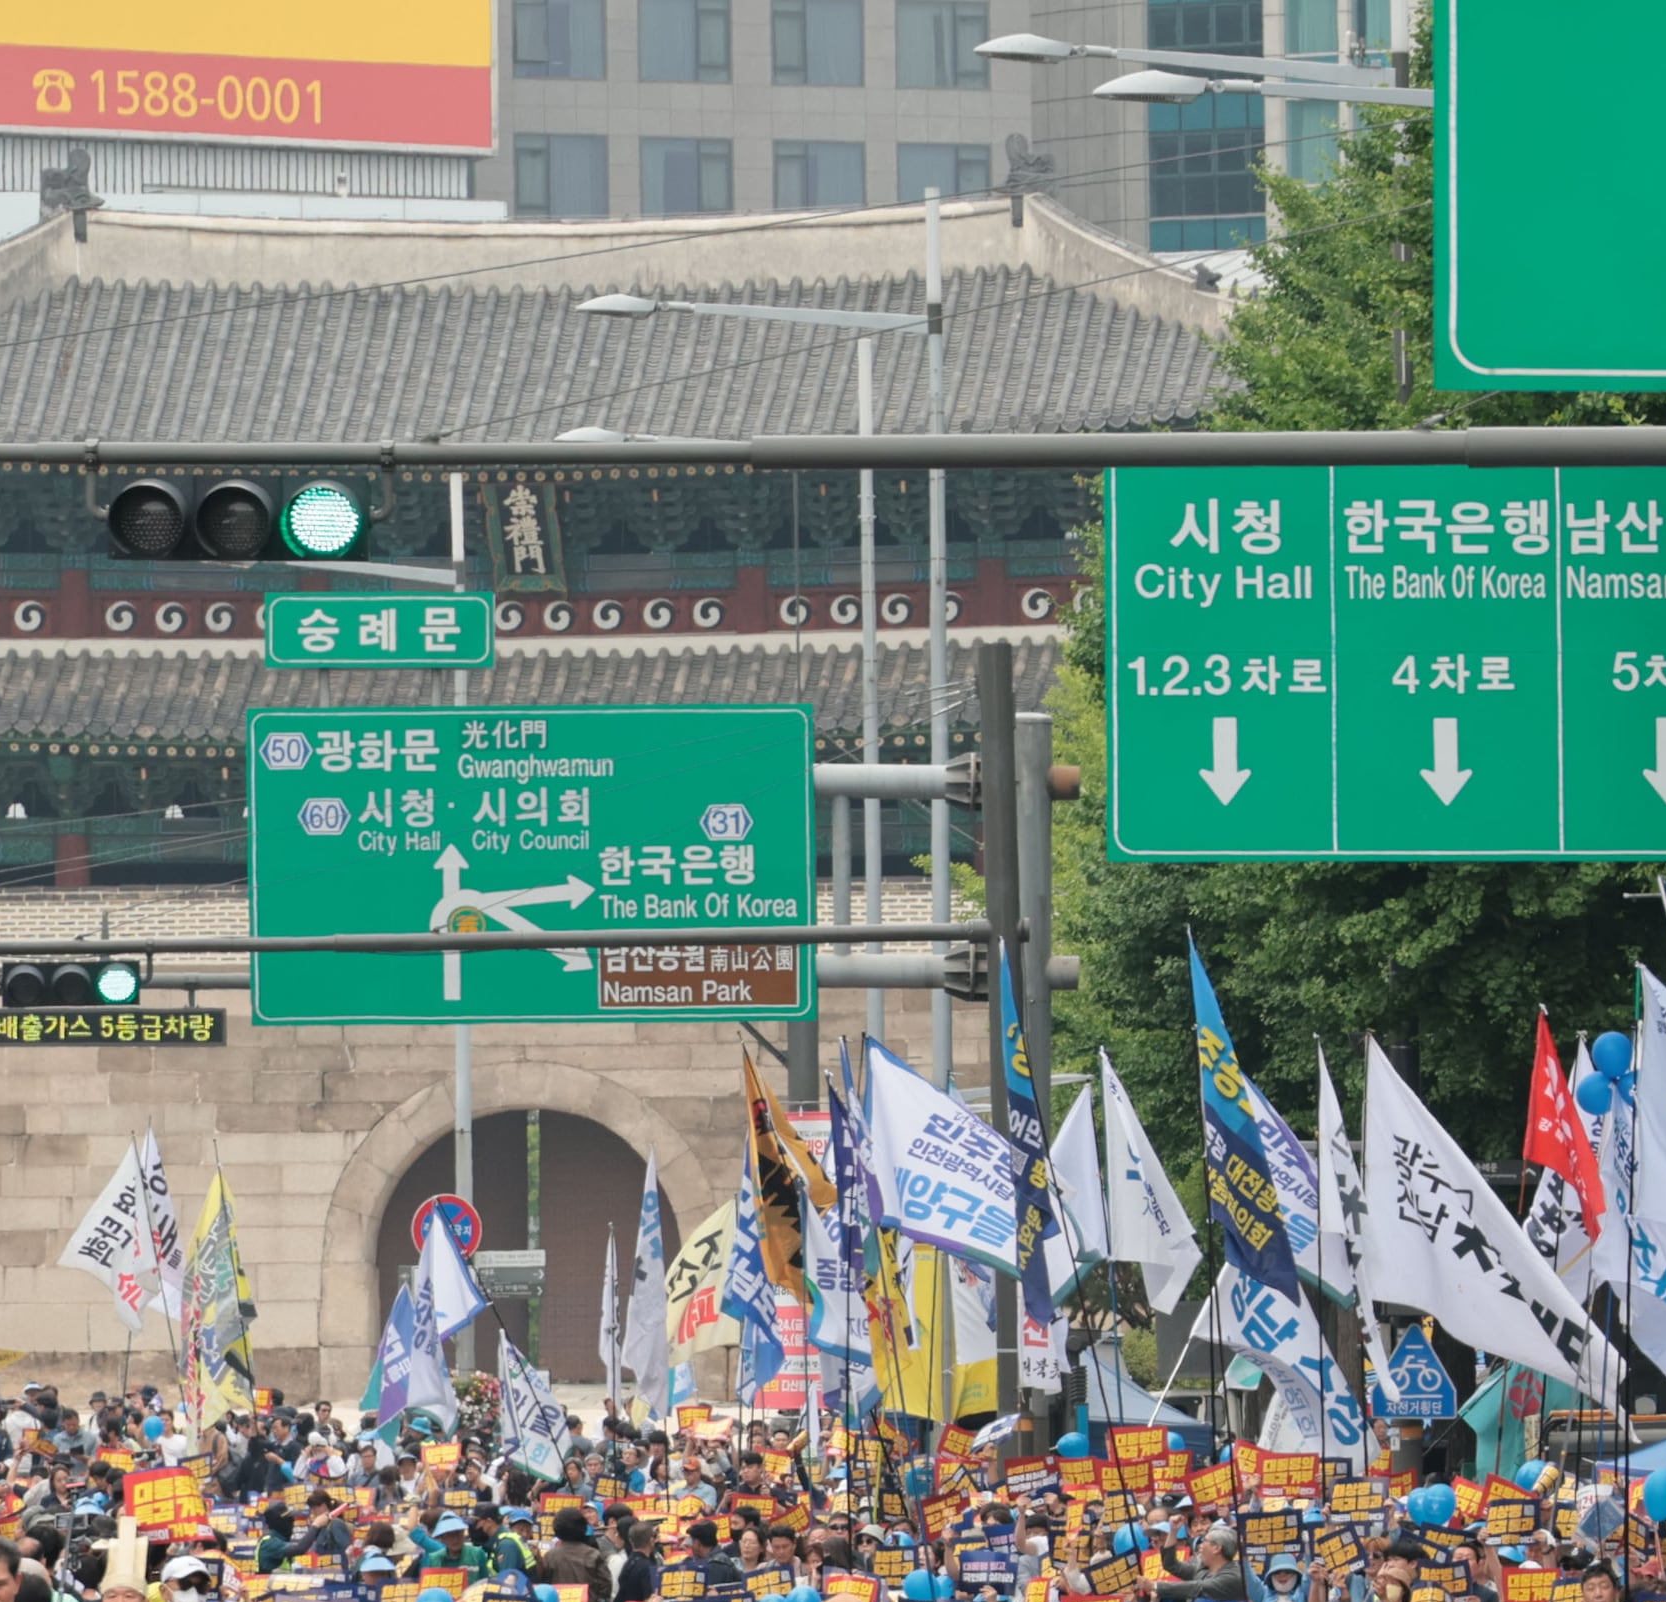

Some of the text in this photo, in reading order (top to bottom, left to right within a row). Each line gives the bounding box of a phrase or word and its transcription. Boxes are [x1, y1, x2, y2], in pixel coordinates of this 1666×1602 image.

[90, 68, 323, 124] 1588-0001
[503, 484, 546, 573] 崇禮門
[1170, 498, 1281, 554] 시청
[1343, 499, 1550, 556] 한국은행
[1134, 564, 1312, 607] City Hall
[1345, 565, 1546, 599] The Bank Of Korea
[297, 607, 461, 653] 숭례문
[270, 738, 303, 763] 50
[315, 729, 440, 773] 광화문
[461, 721, 547, 750] 光化門
[458, 755, 614, 784] Gwanghwamun
[309, 805, 338, 829] 60
[358, 787, 591, 827] 시청 시의회
[710, 810, 742, 835] 31
[358, 830, 589, 856] City Hall City Council
[599, 845, 756, 885] 한국은행
[599, 894, 797, 919] The Bank Of Korea
[603, 980, 752, 1003] Namsan Park
[100, 1014, 213, 1041] 5등급차량
[1386, 1401, 1442, 1414] 자전거횡단
